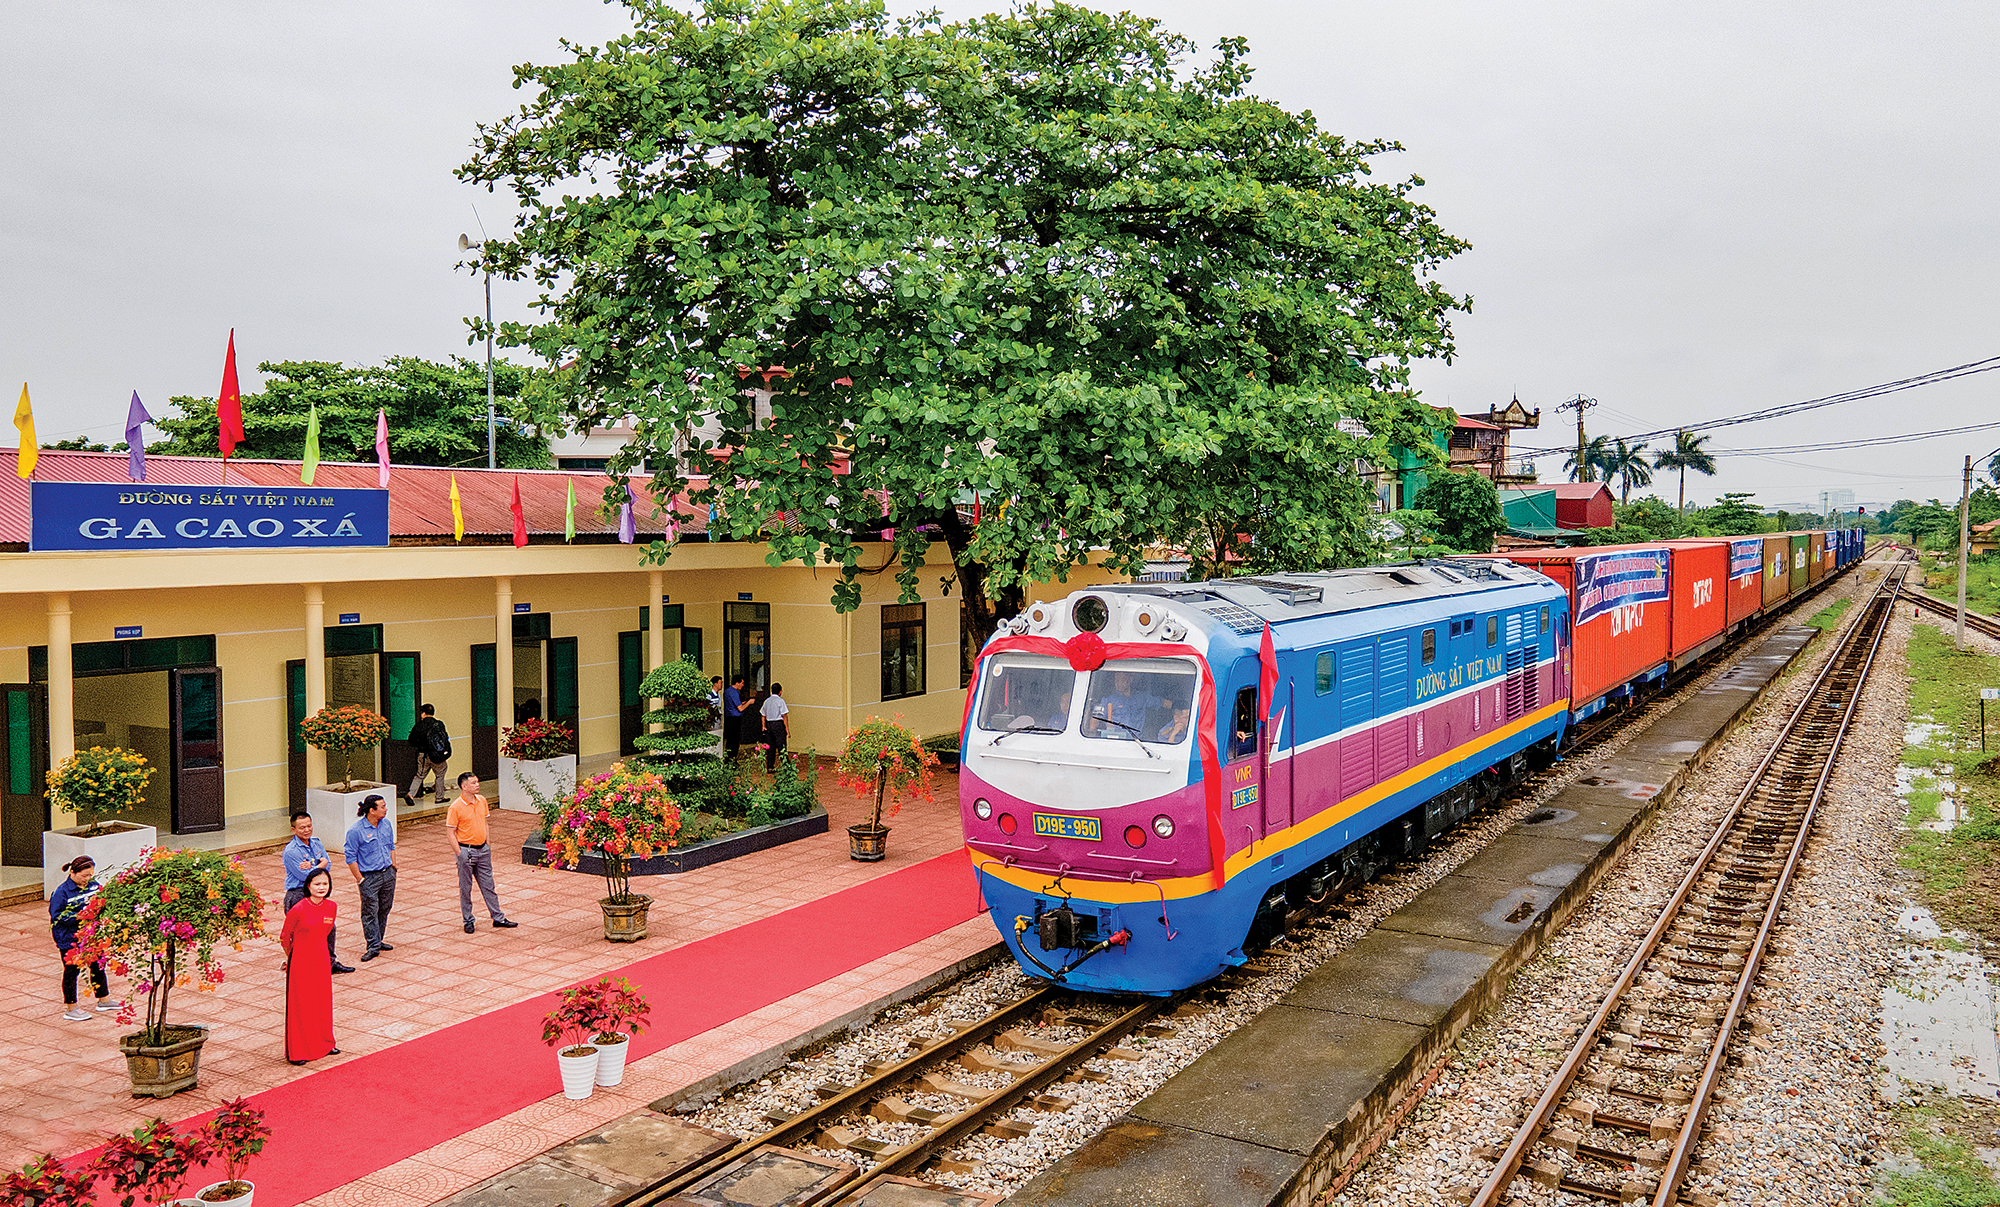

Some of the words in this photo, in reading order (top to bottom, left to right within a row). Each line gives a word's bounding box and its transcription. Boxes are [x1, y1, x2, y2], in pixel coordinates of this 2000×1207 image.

[119, 488, 193, 505] ĐƯỜNG
[199, 489, 237, 506] SẮT
[242, 491, 288, 508] VIỆT
[293, 495, 335, 506] NAM
[78, 518, 166, 539] GA
[175, 518, 285, 539] CAO
[292, 512, 363, 538] XÁ
[1416, 668, 1445, 699] ĐƯỜNG
[1449, 656, 1462, 688] SẮT
[1466, 654, 1483, 682] VIỆT
[1486, 653, 1502, 676] NAM
[1234, 765, 1252, 783] VNR
